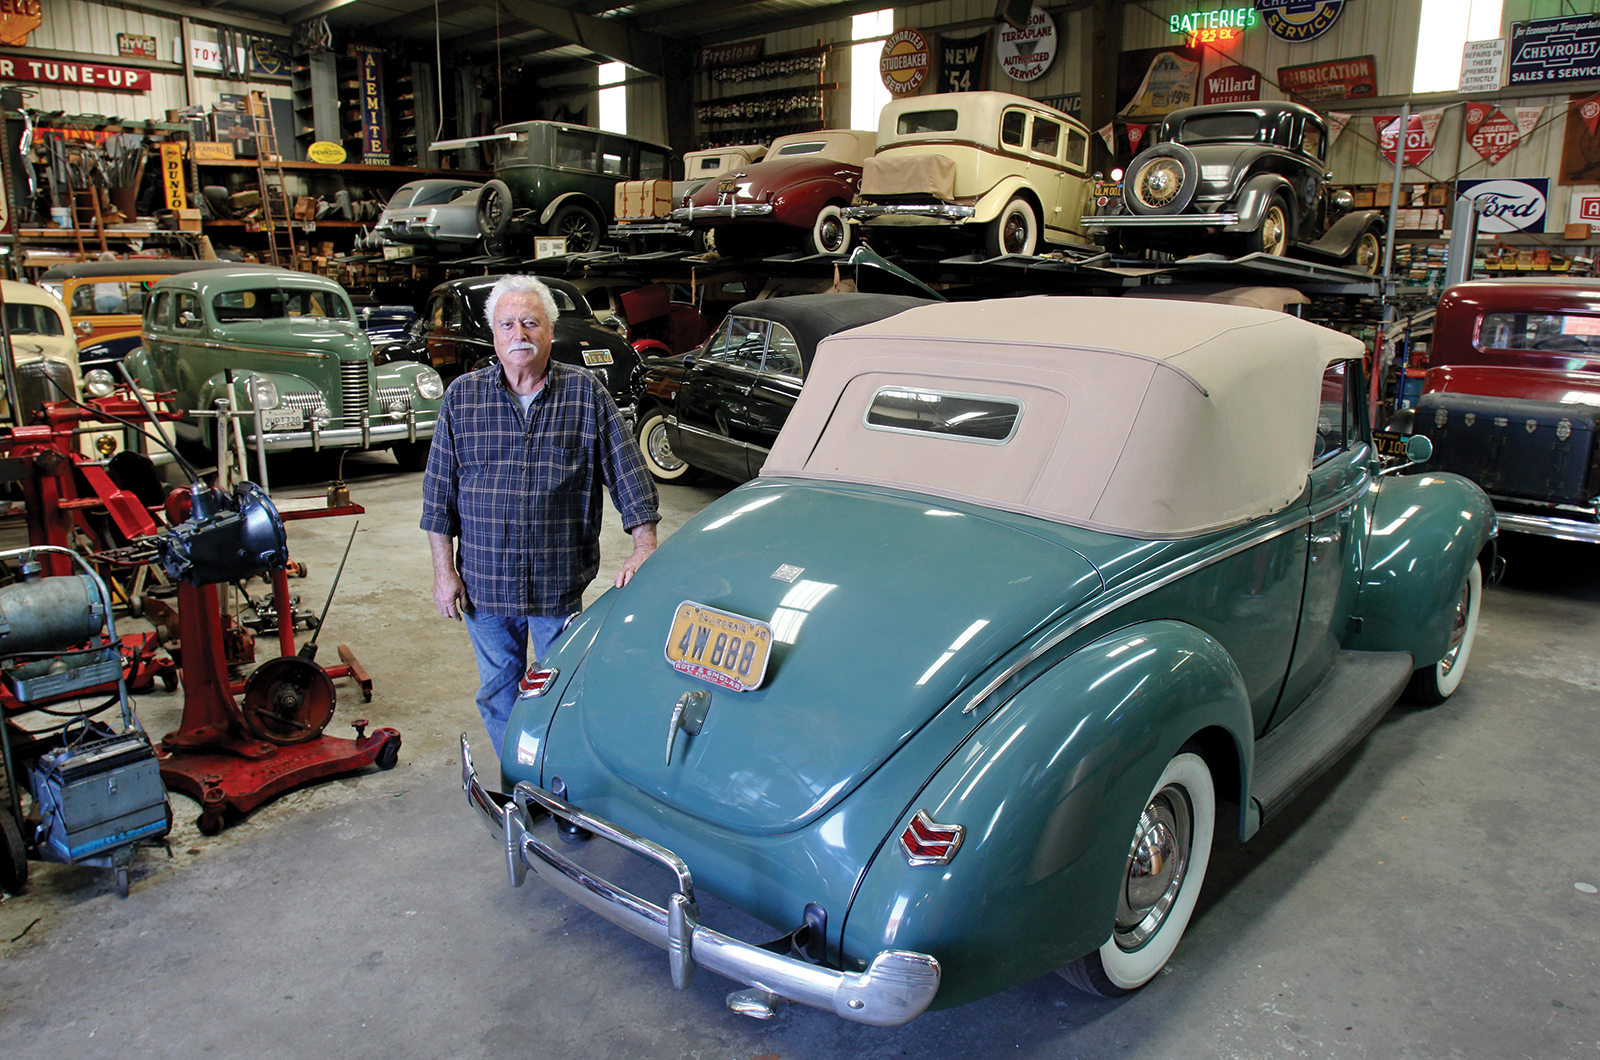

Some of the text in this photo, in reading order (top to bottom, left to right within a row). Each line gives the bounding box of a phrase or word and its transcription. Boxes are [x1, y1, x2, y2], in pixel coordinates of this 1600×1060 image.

[1170, 8, 1255, 33] BATTERIES
[1268, 6, 1335, 38] SERVICE
[1002, 26, 1052, 42] TERRAPLANE
[1525, 24, 1559, 36] Economical
[885, 30, 924, 54] AUTHORIZED
[1522, 42, 1597, 59] CHEVROLET
[701, 45, 757, 66] Firestone
[881, 53, 927, 71] STUDEBAKER
[945, 46, 978, 64] NEW
[1003, 52, 1049, 66] AUTHORIZED
[1465, 49, 1502, 59] REPAIRS ON
[1472, 58, 1492, 66] THESE
[28, 62, 139, 87] TUNE-UP
[1009, 64, 1043, 79] SERVICE
[1465, 67, 1497, 75] PREMISES
[1512, 71, 1544, 82] SALES
[1547, 69, 1555, 79] &
[884, 71, 923, 93] SERVICE
[1208, 75, 1256, 94] Willard
[1460, 84, 1498, 92] PROHIBITED
[1465, 76, 1495, 84] STRICTLY
[365, 54, 382, 153] ALEMITE
[1211, 95, 1251, 104] BATTERIES
[1472, 133, 1519, 147] STOP
[699, 612, 749, 635] CALIFORNIA
[710, 632, 756, 677] 888
[706, 670, 740, 690] SMOLAR
